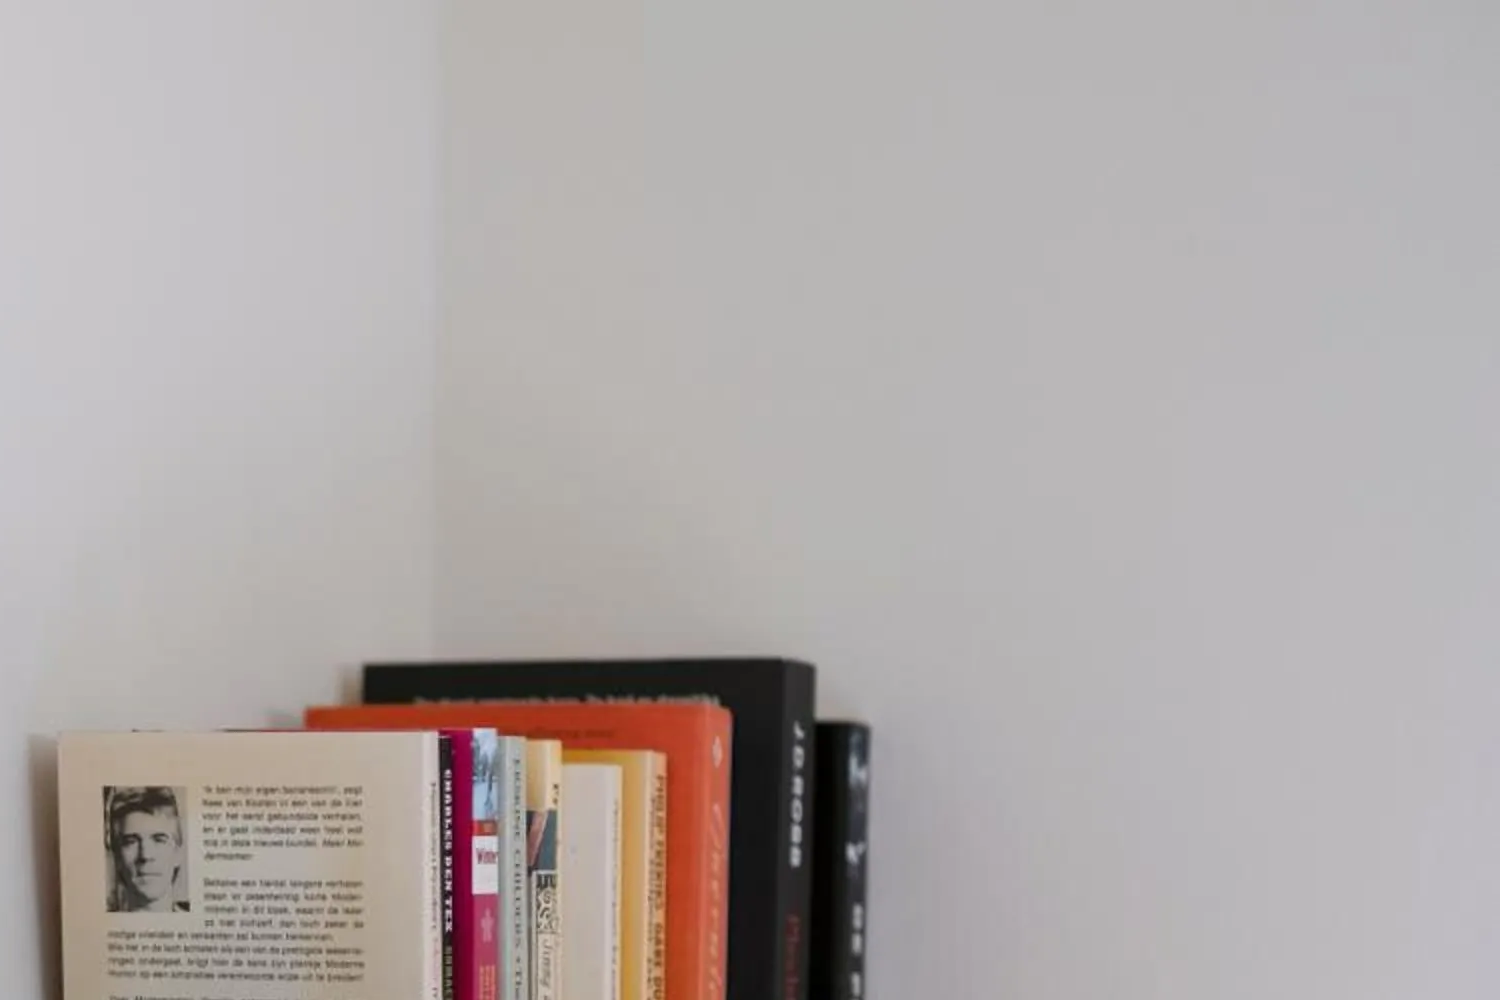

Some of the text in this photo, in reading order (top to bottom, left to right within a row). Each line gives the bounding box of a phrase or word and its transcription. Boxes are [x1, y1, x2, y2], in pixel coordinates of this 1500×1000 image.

[444, 769, 453, 850] CHARLES
[444, 856, 453, 891] DEN
[445, 896, 453, 932] TEX
